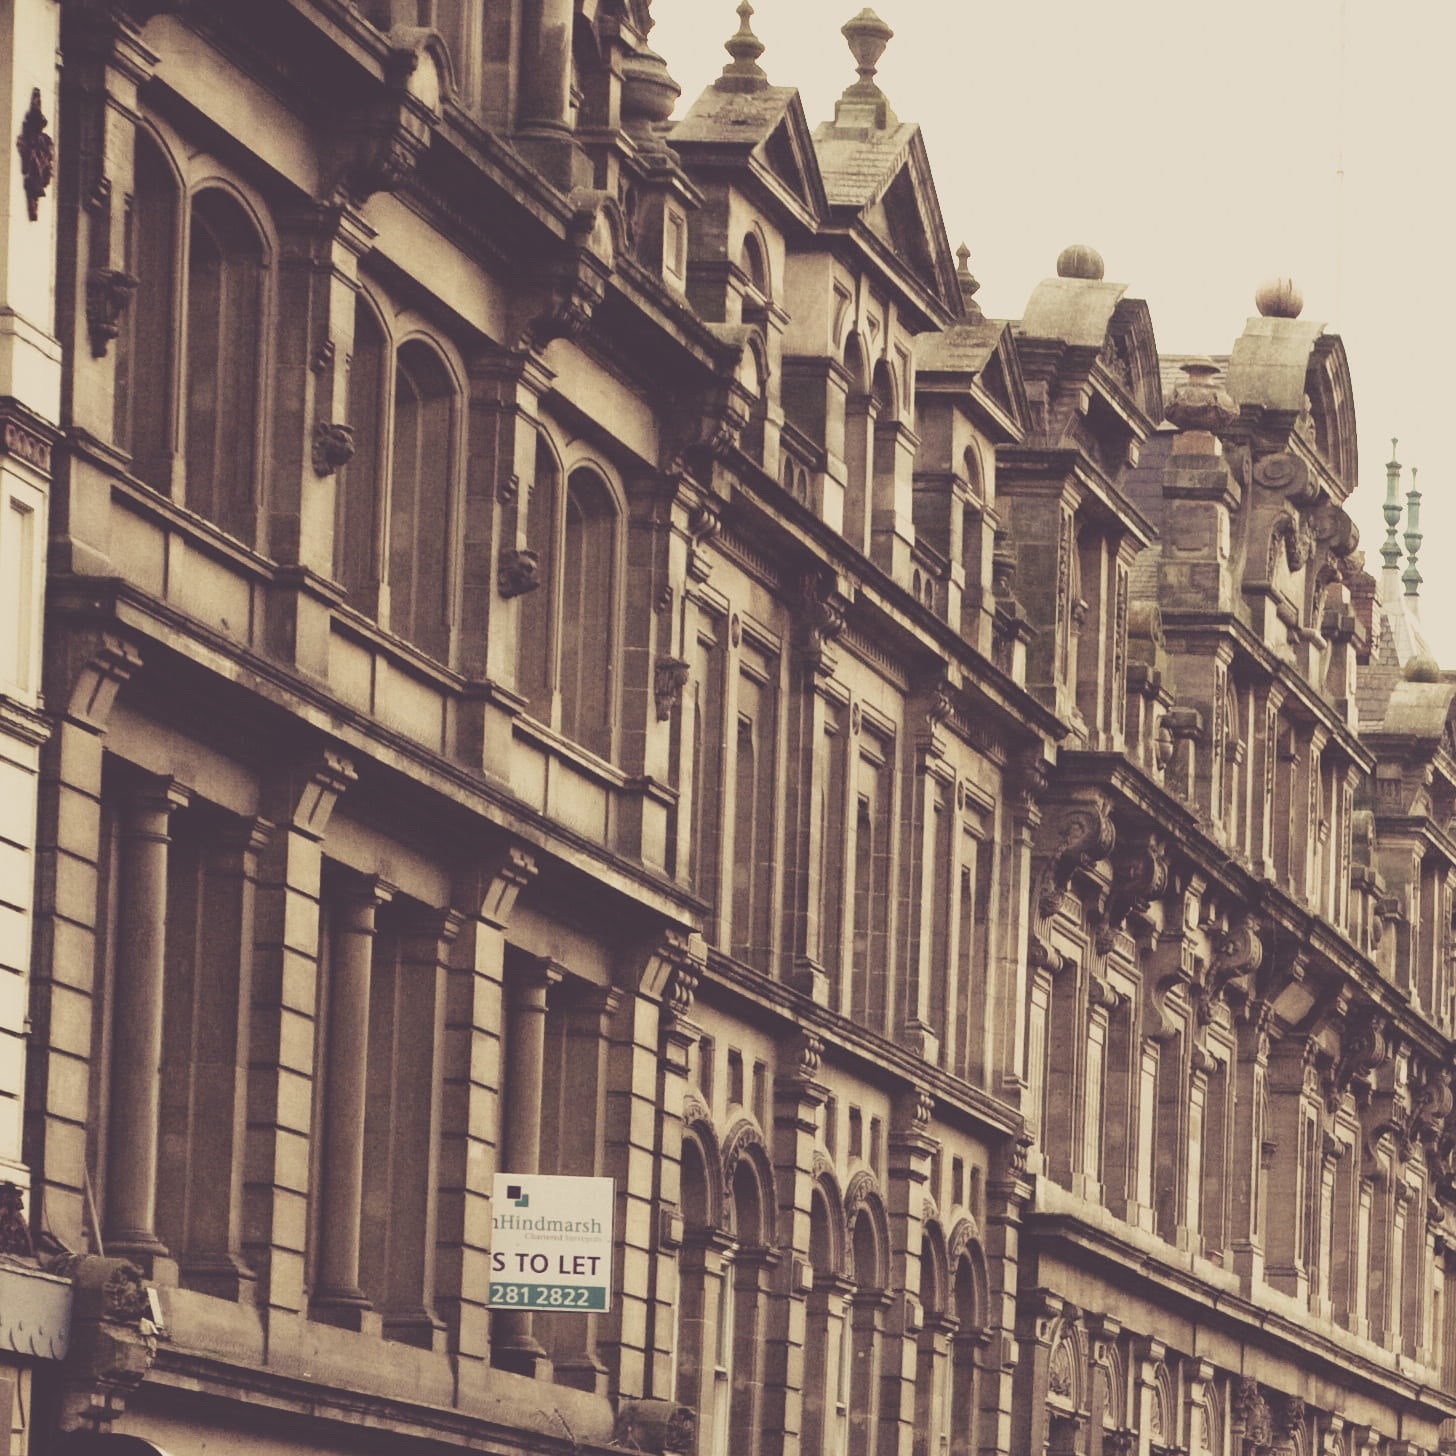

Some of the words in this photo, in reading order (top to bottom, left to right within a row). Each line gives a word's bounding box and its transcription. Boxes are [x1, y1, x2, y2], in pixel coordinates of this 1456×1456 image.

[515, 1253, 549, 1274] TO
[559, 1255, 601, 1276] LET
[491, 1285, 529, 1304] 281
[536, 1287, 590, 1306] 2822
